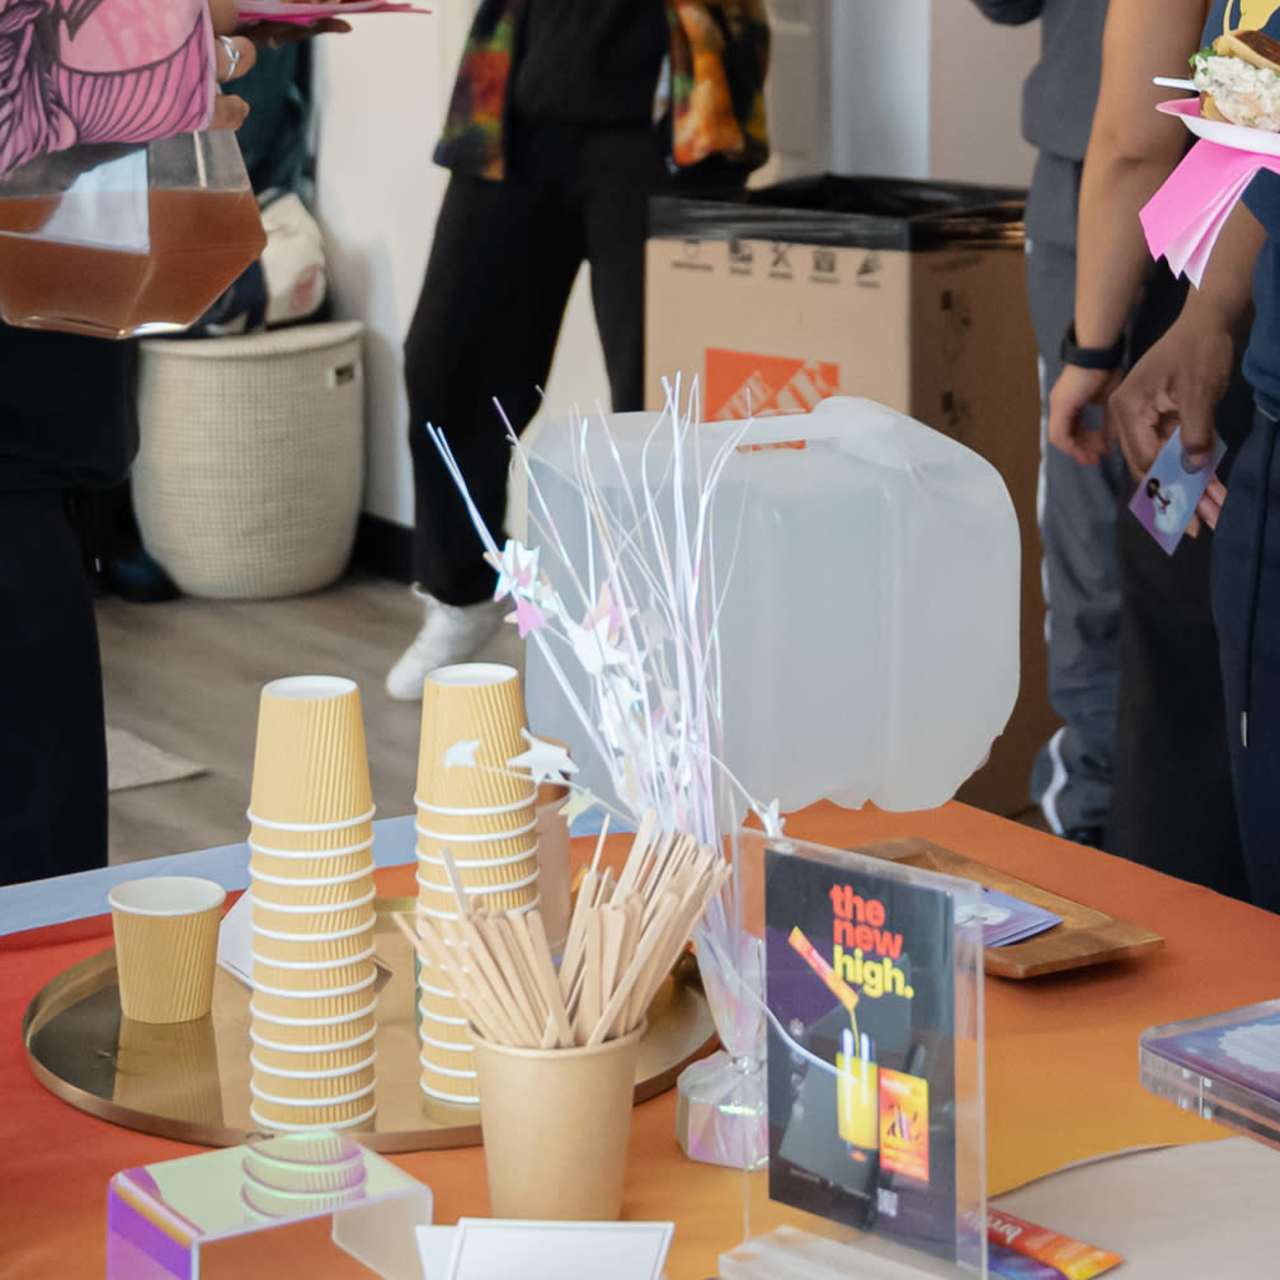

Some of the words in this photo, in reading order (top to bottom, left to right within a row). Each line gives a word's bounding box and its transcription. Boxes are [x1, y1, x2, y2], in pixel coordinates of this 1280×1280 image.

[829, 883, 886, 929] the
[833, 917, 903, 960] new
[833, 943, 915, 999] high.
